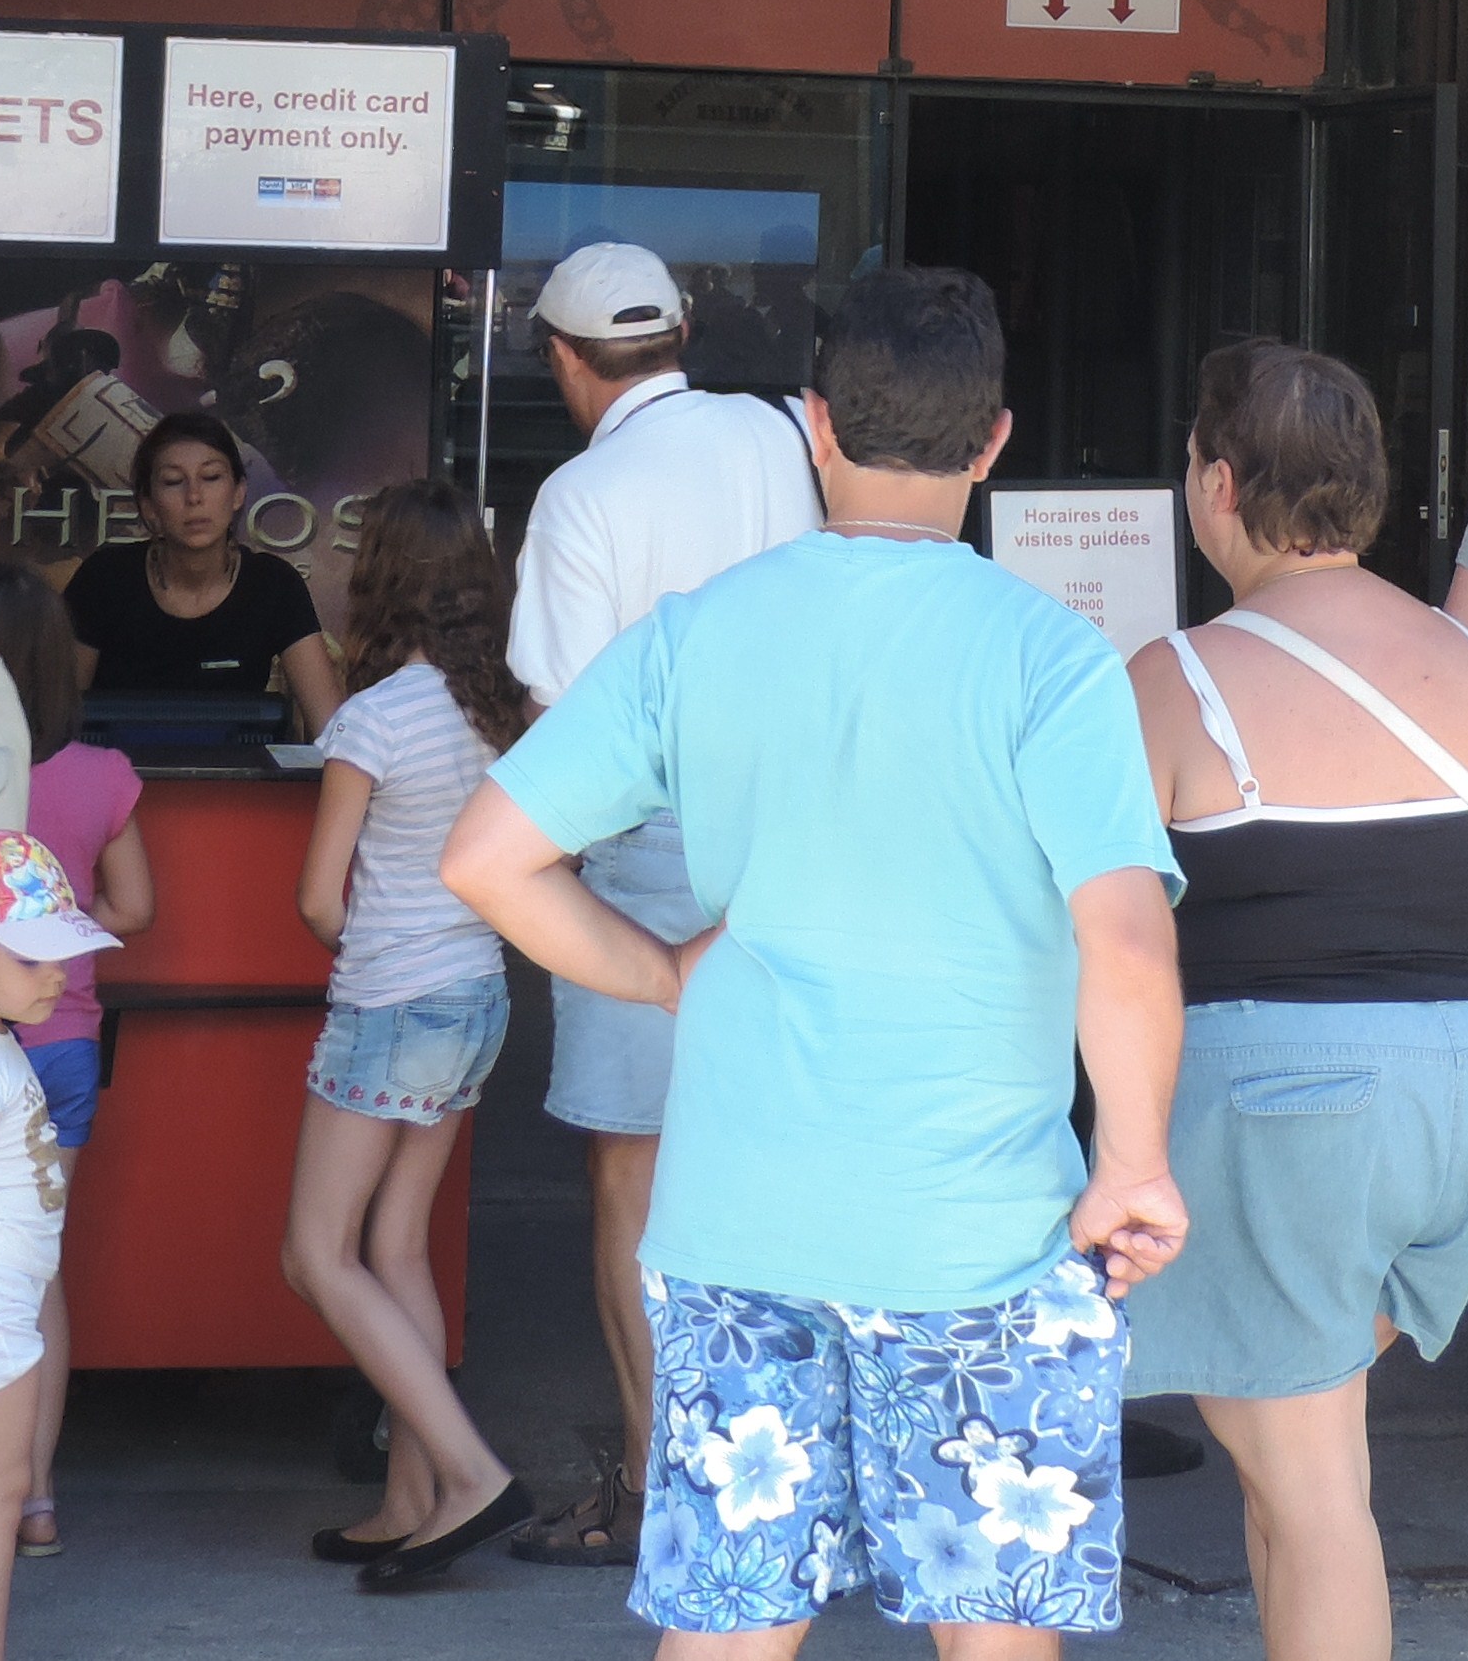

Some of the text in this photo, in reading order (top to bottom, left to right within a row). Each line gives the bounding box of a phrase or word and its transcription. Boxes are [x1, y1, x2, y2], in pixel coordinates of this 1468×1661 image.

[187, 84, 429, 114] Here, credit card
[205, 126, 408, 156] payment only.
[12, 486, 365, 551] HEOS
[1024, 508, 1139, 523] Horaires des
[1014, 529, 1151, 550] visites guidées
[1064, 581, 1103, 594] 11h00
[1064, 598, 1104, 611] 12h00
